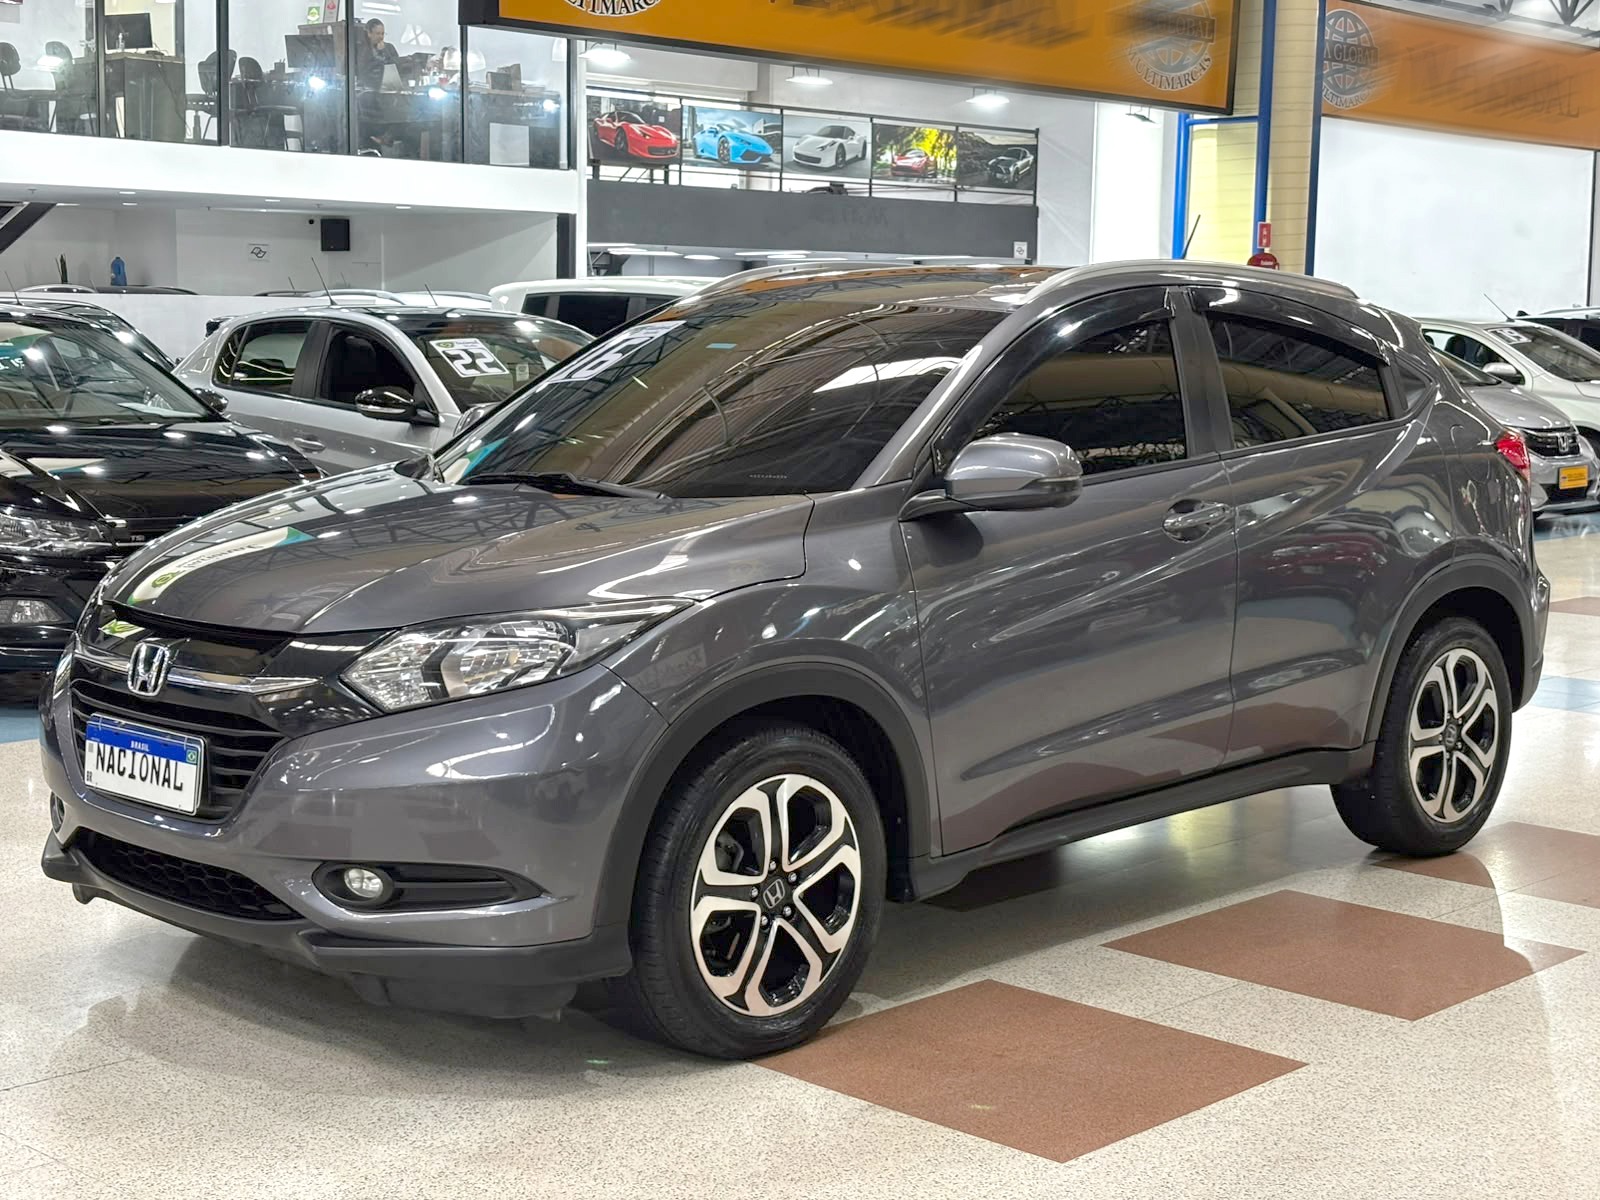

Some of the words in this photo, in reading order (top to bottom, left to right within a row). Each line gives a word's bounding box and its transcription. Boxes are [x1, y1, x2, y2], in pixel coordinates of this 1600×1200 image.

[443, 348, 504, 375] 22
[130, 740, 150, 752] BRASIL
[96, 743, 183, 791] NACIONAL
